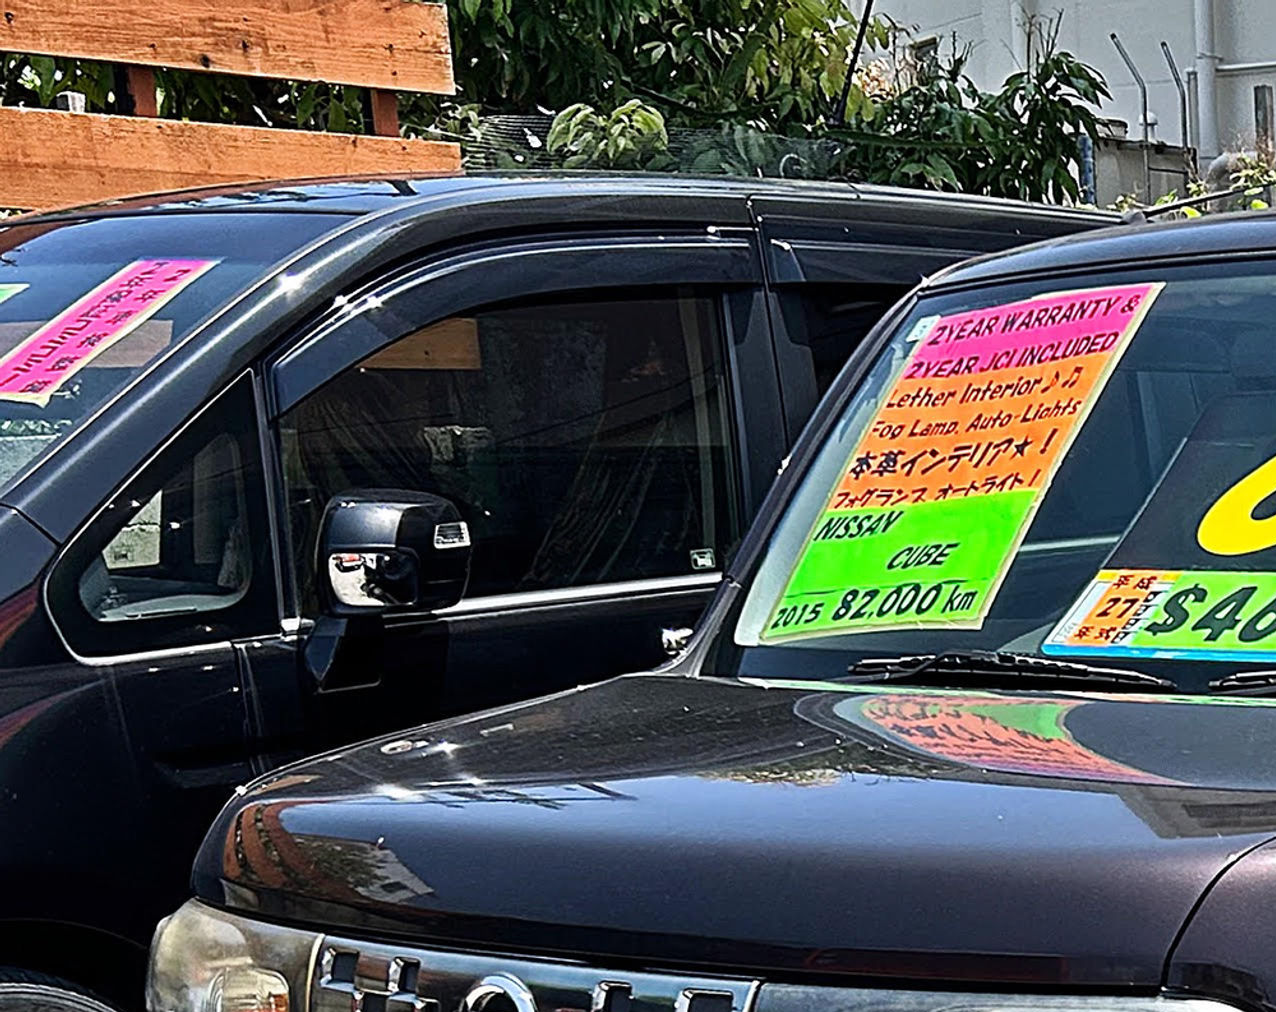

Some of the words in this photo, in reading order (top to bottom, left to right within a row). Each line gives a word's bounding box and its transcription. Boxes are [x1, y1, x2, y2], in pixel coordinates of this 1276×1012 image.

[927, 315, 1000, 346] 2YEAR
[1001, 296, 1122, 333] WARRANTY
[1120, 294, 1142, 314] &
[903, 355, 980, 380] 2YEAR
[979, 348, 1018, 373] JCI
[1016, 331, 1120, 367] INCLUDED
[959, 376, 1044, 405] Interior
[813, 511, 905, 541] NISSAN
[887, 542, 961, 570] CUBE
[770, 602, 825, 630] 2015
[831, 583, 944, 621] 82,000
[941, 585, 979, 614] km
[1095, 597, 1140, 619] 27
